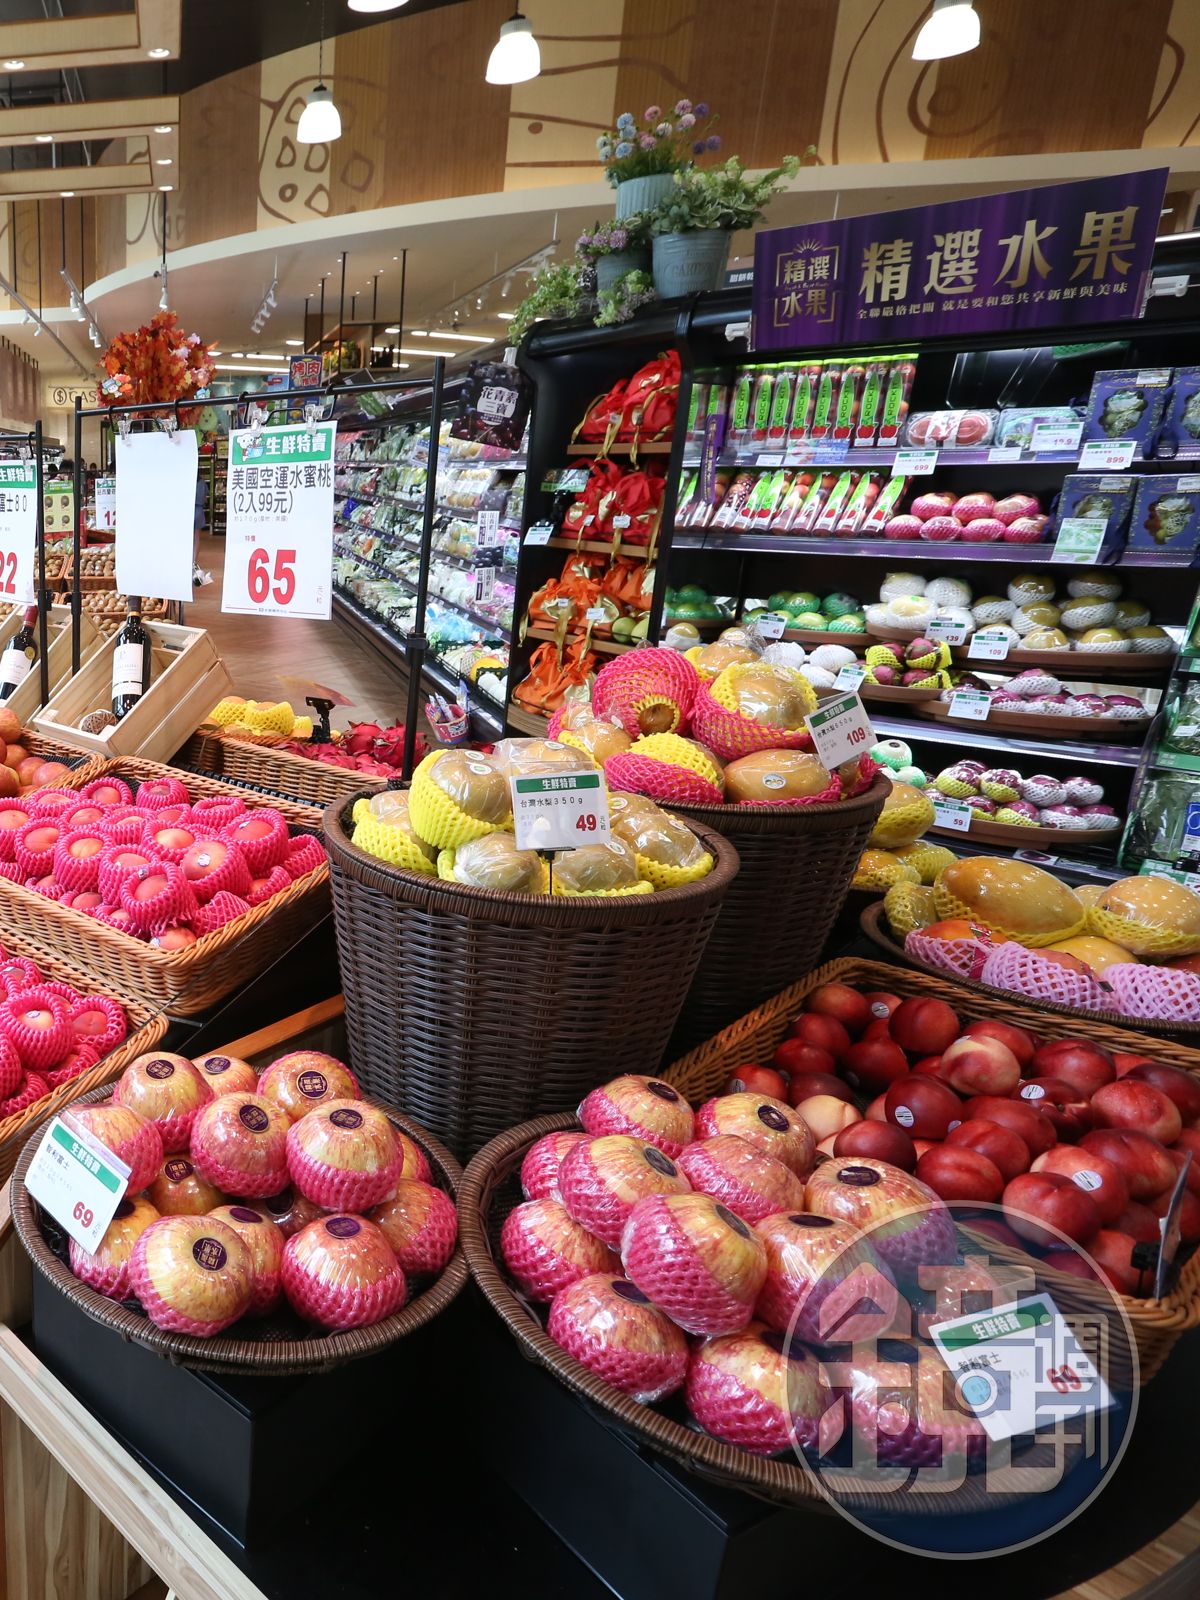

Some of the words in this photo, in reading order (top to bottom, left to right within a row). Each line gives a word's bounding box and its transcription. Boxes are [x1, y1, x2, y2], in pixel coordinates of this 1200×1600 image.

[858, 206, 1139, 304] 精選水果
[784, 256, 831, 284] 精選
[782, 289, 828, 318] 水果
[265, 432, 327, 455] 生鮮特賣
[1106, 456, 1125, 464] 899
[231, 463, 331, 490] 美國空運水蜜桃
[233, 490, 294, 514] (2入99元)
[247, 548, 297, 605] 65
[847, 727, 866, 746] 109
[542, 777, 577, 790] 生鮮特賣
[576, 814, 597, 831] 49
[953, 818, 964, 826] 59
[73, 1201, 94, 1229] 69
[971, 1313, 1022, 1340] 生鮮特賣
[1046, 1364, 1083, 1394] 69
